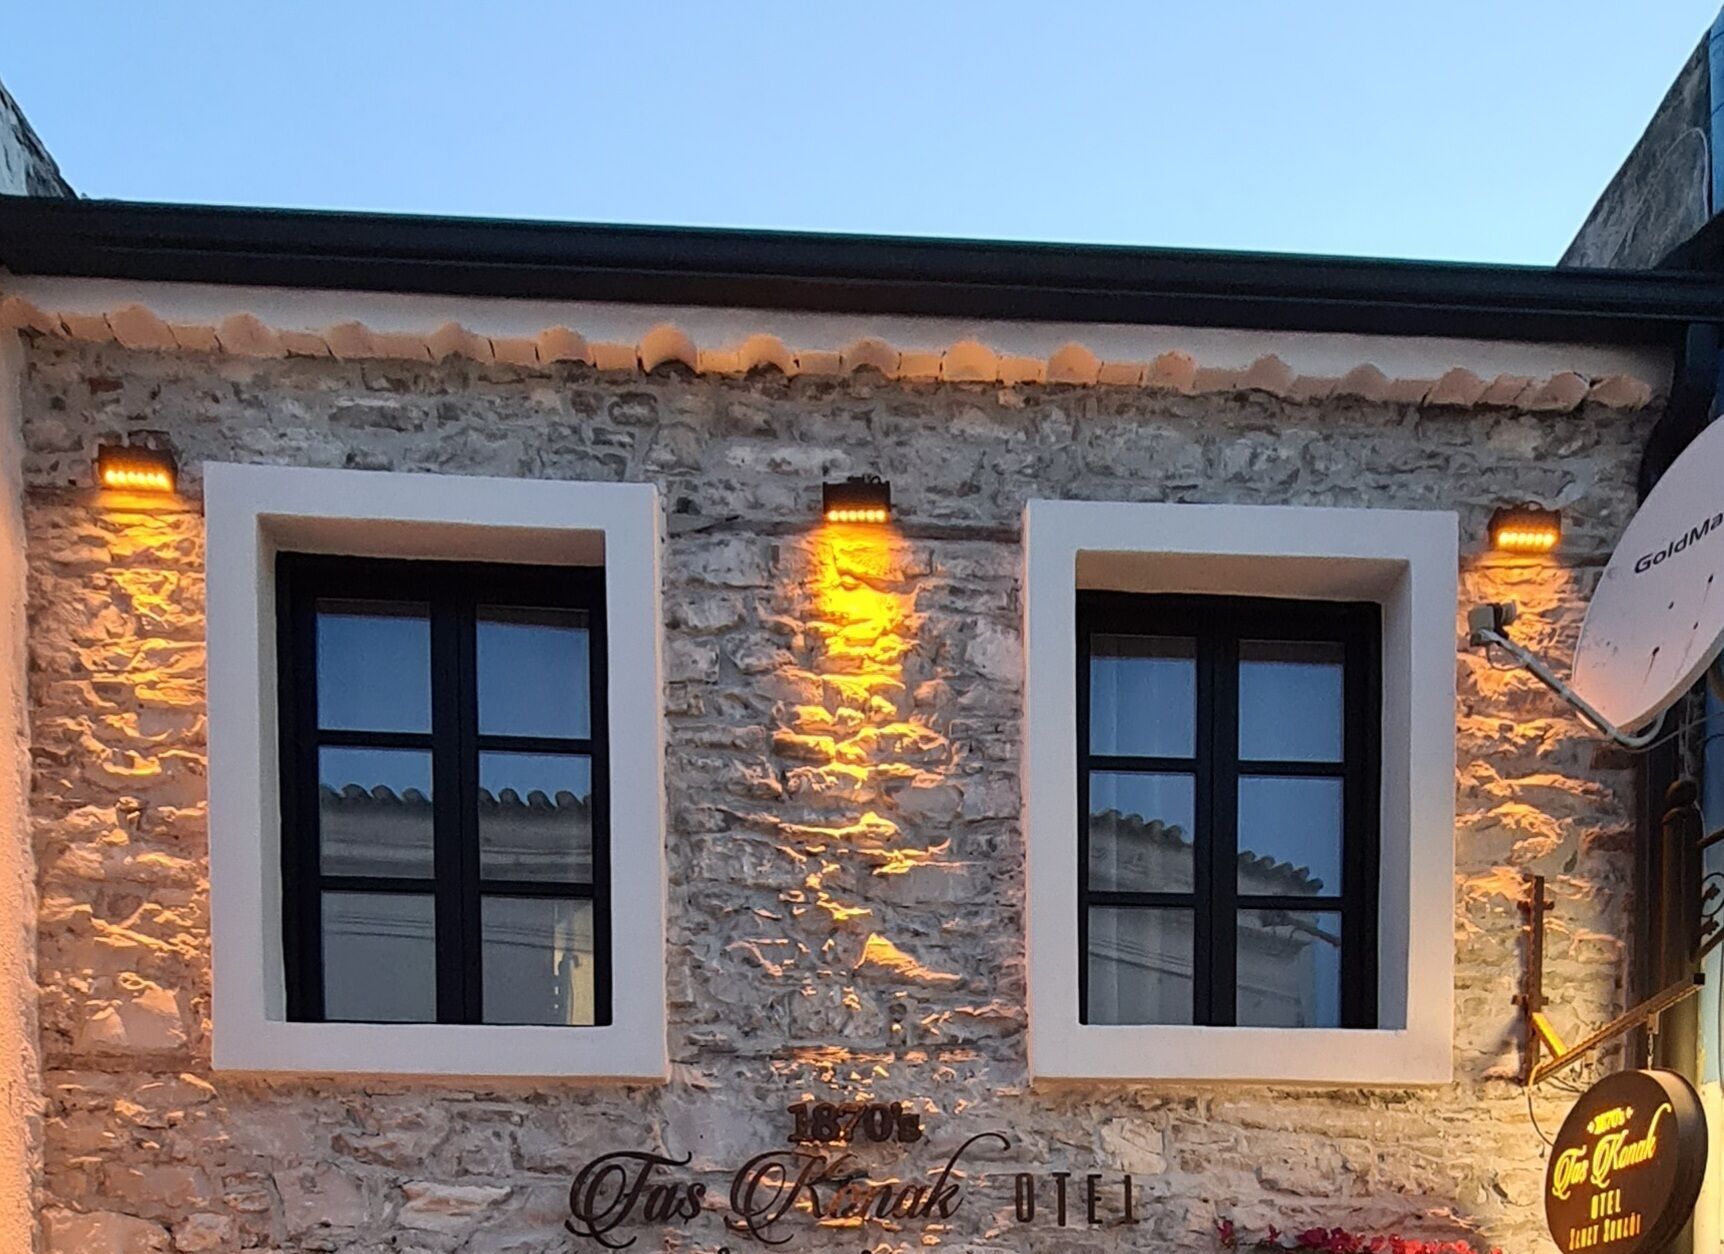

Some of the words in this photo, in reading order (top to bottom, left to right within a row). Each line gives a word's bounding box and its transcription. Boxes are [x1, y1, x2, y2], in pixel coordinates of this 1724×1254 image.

[787, 1101, 922, 1143] 1870's
[1591, 1103, 1672, 1188] Konak
[564, 1150, 706, 1249] Taş
[723, 1132, 1011, 1245] Konak
[1015, 1172, 1140, 1227] OTEL
[1591, 1188, 1621, 1219] OTEL
